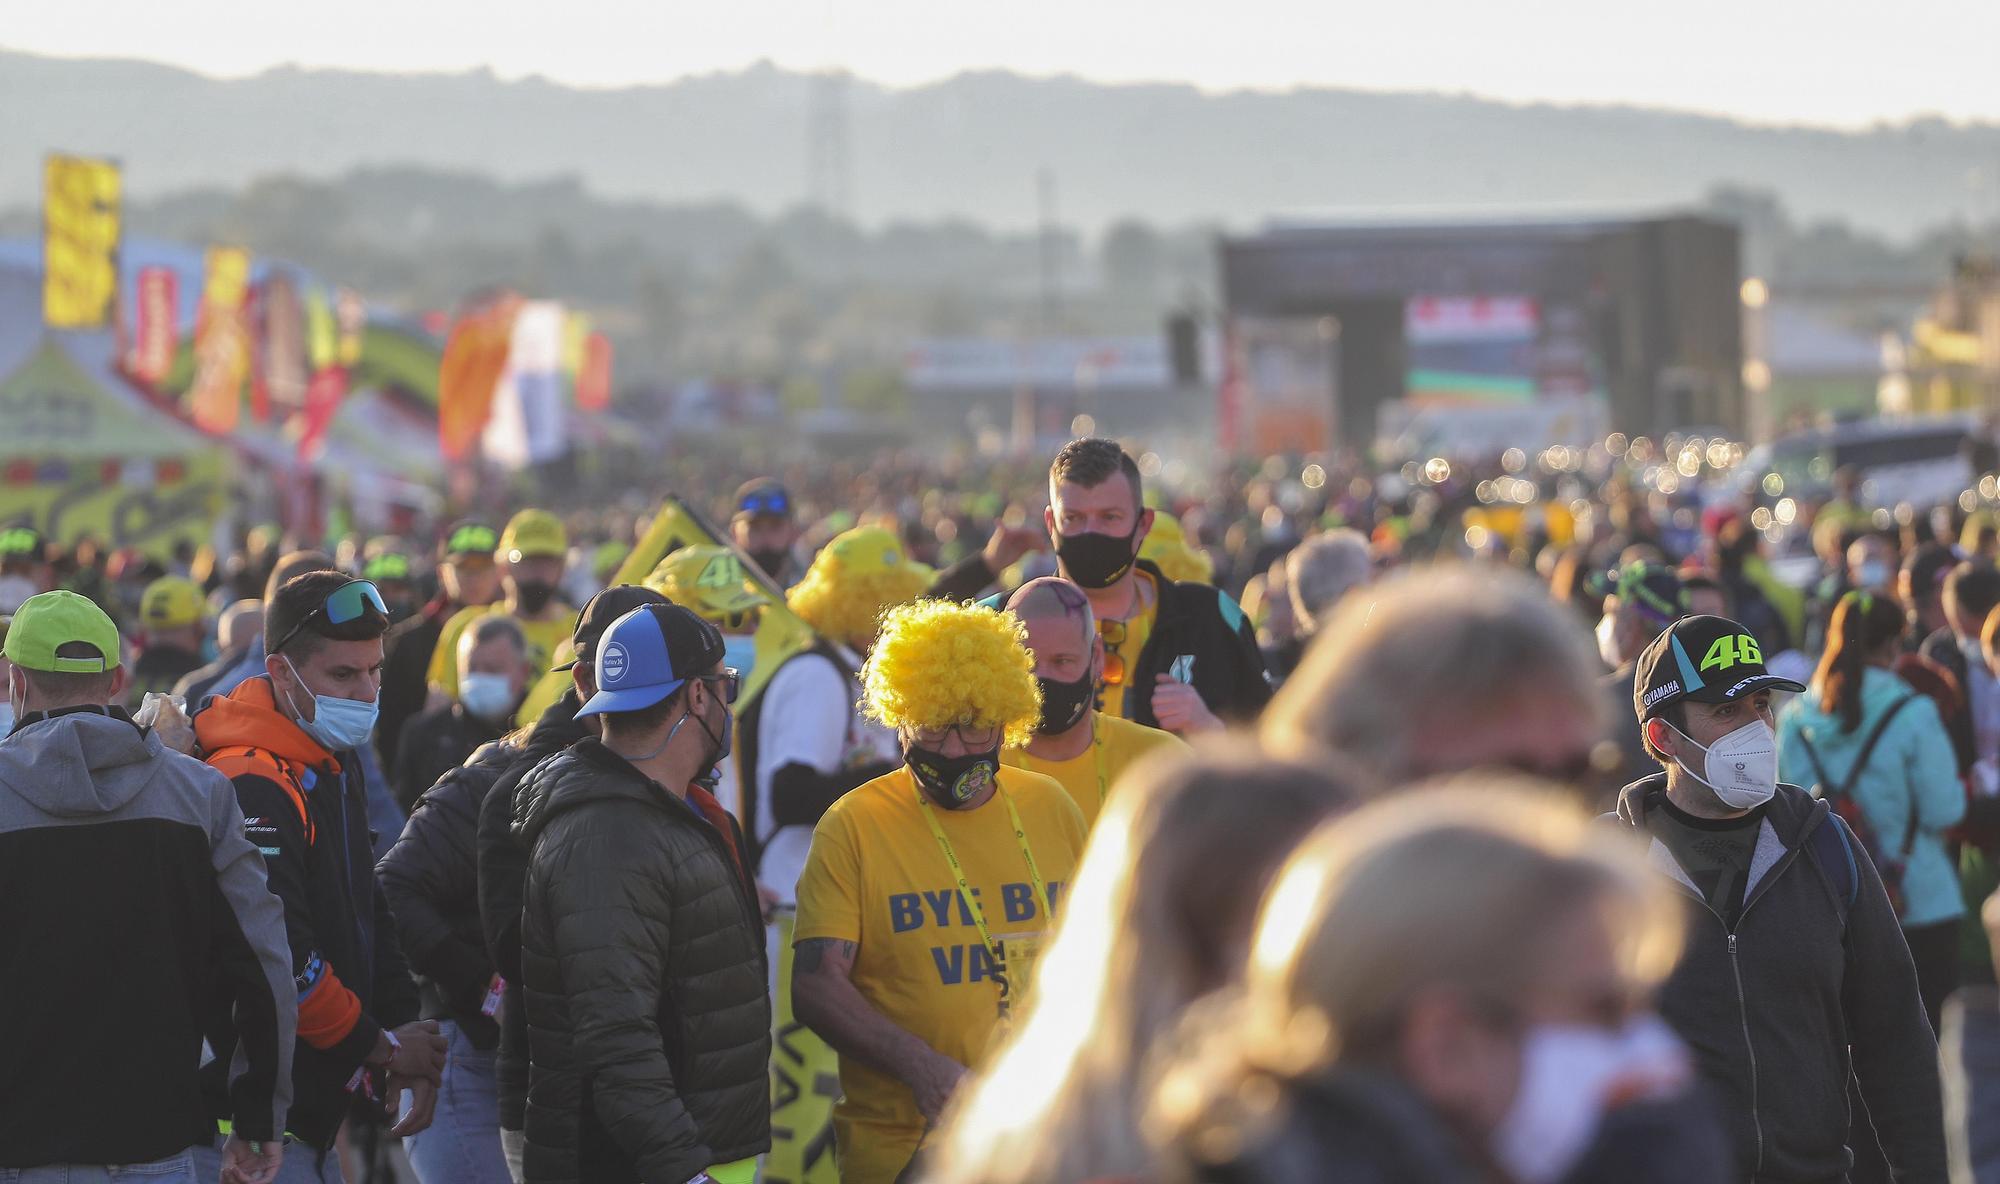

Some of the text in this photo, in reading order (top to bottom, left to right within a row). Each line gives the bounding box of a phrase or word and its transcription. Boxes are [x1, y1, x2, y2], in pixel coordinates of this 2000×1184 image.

[1700, 634, 1763, 672] 46
[1648, 680, 1680, 702] YAMAHA
[1725, 674, 1768, 697] PETR
[888, 888, 988, 934] BYE
[1001, 881, 1066, 923] BY
[930, 943, 998, 985] VA
